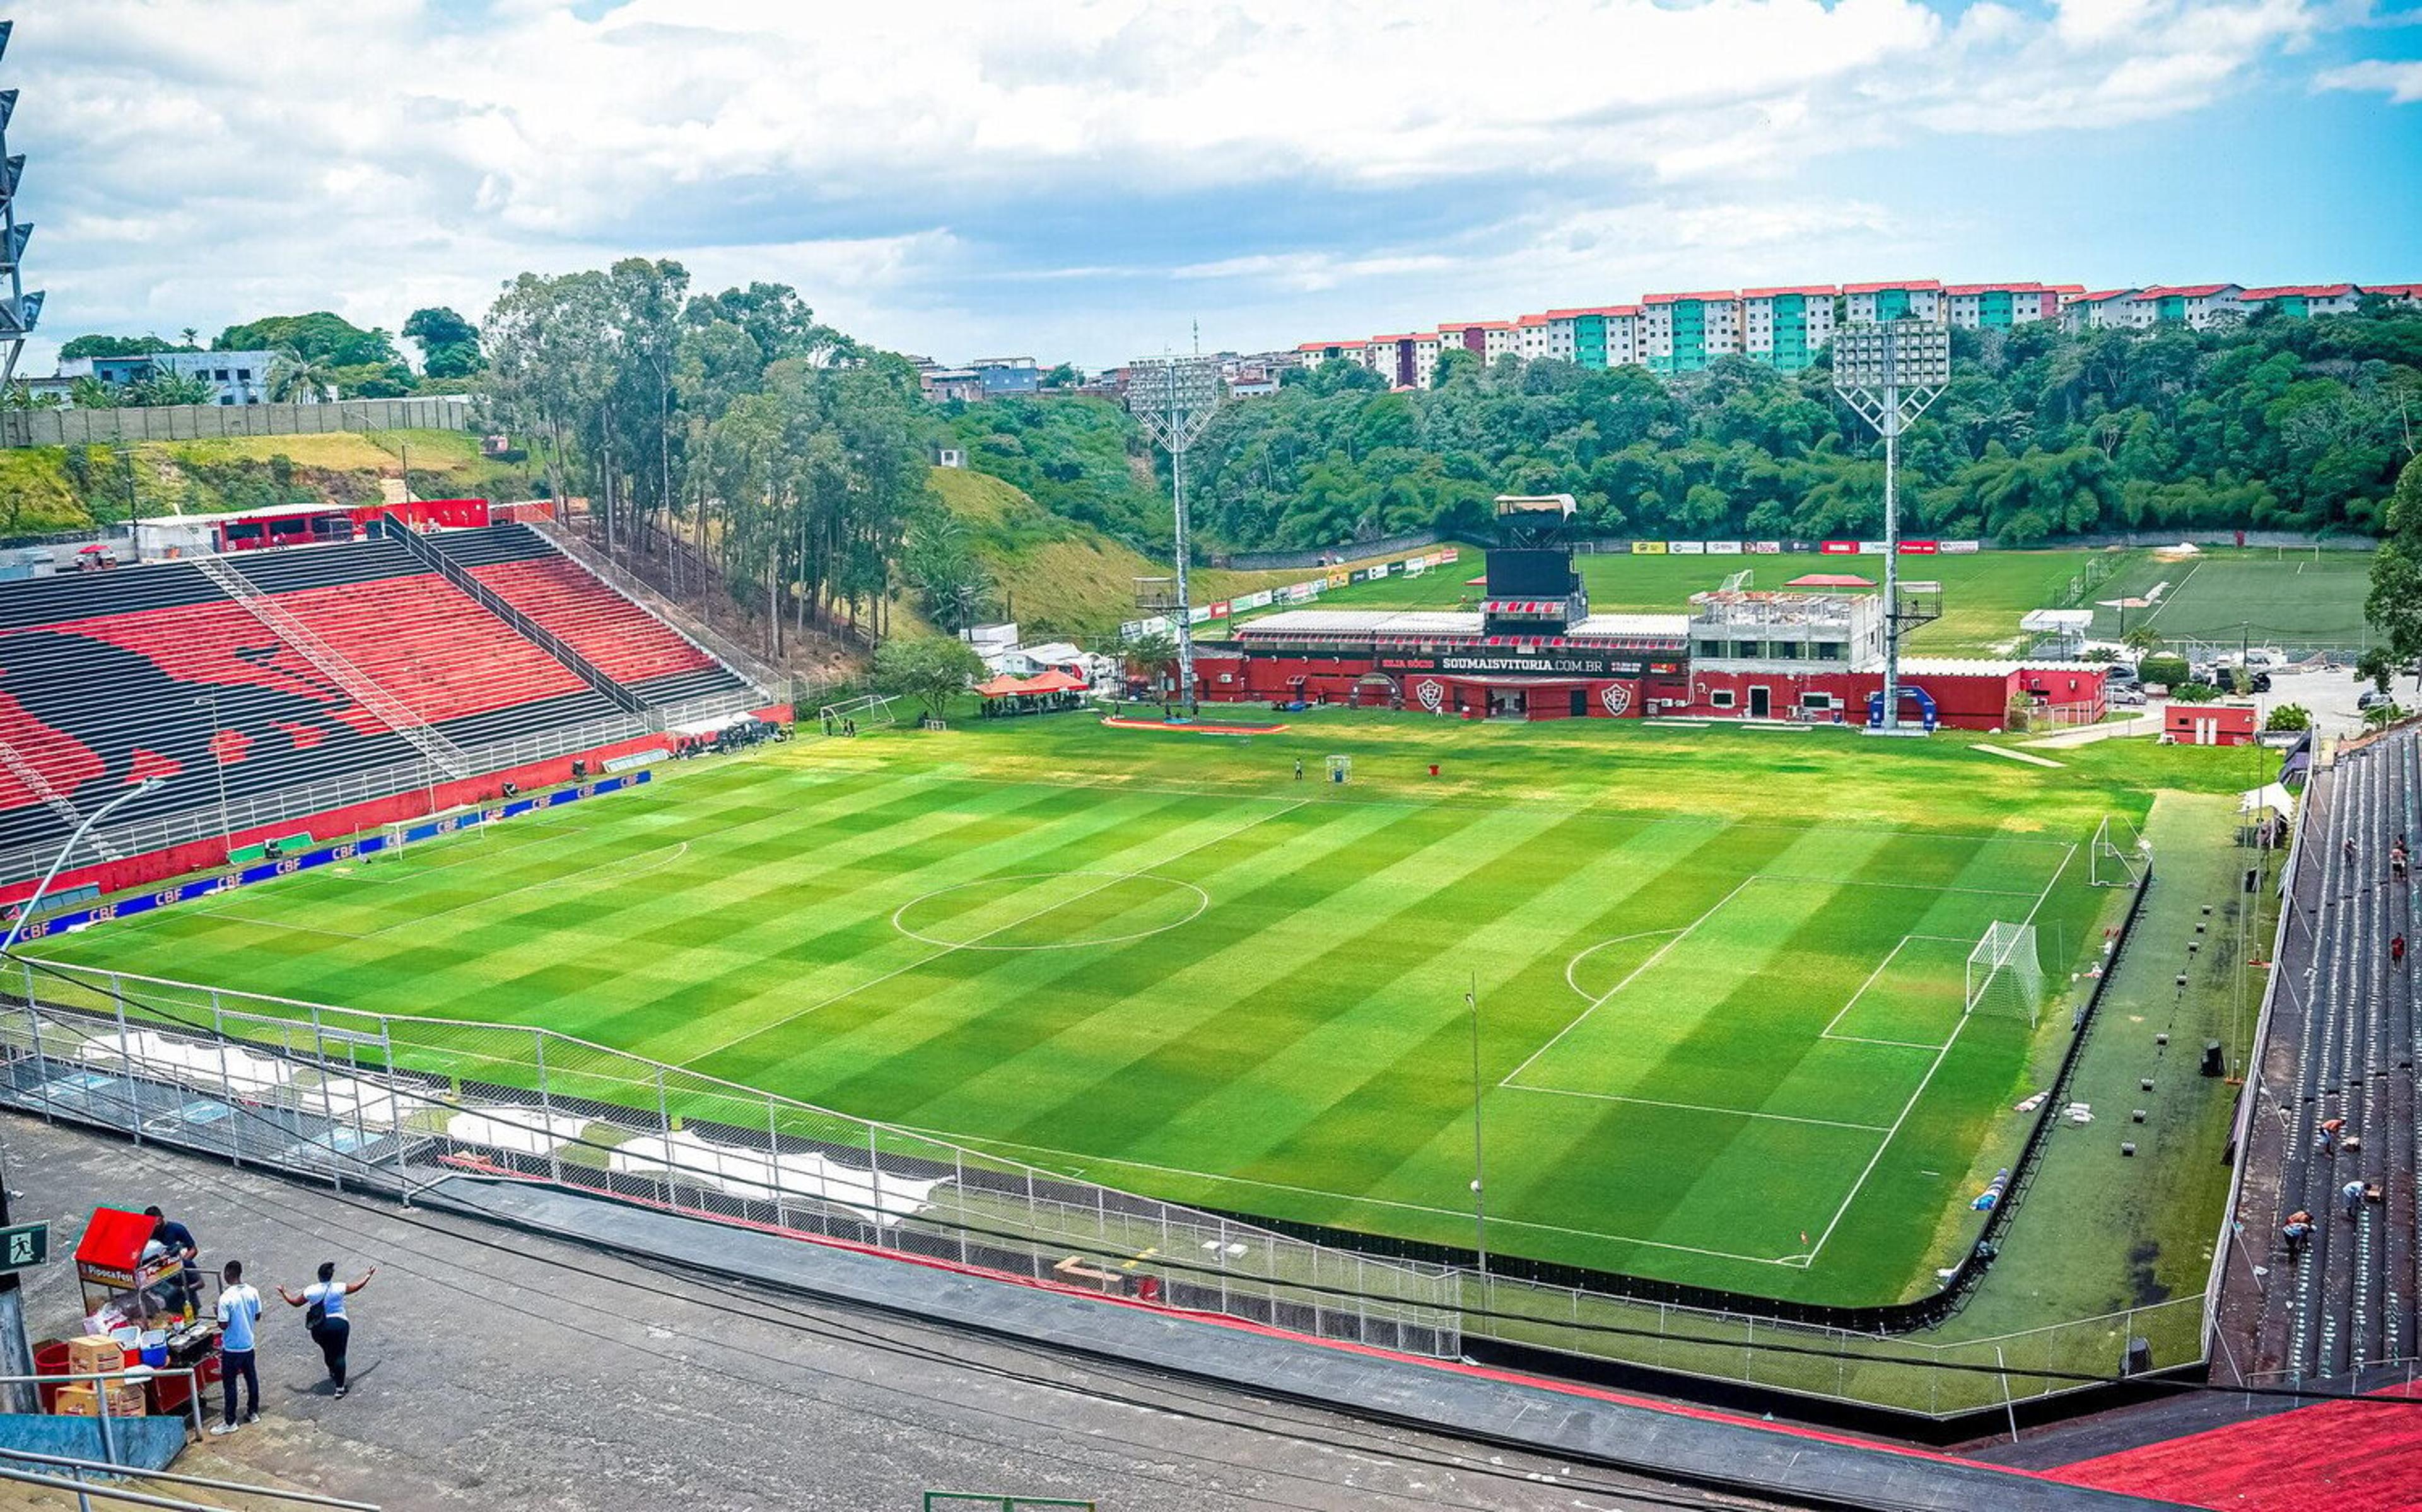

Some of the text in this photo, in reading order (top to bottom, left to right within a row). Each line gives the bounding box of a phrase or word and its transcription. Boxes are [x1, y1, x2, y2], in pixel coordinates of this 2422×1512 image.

[1442, 658, 1603, 672] SOUMAISVITORIA.COM.BR
[577, 784, 596, 798] CBF
[532, 795, 552, 810] CBF
[436, 818, 458, 834] CBF
[332, 844, 356, 859] CBF
[276, 858, 301, 874] CBF
[217, 873, 243, 890] CBF
[155, 888, 183, 905] CBF
[90, 905, 119, 922] CBF
[20, 922, 50, 941] CBF
